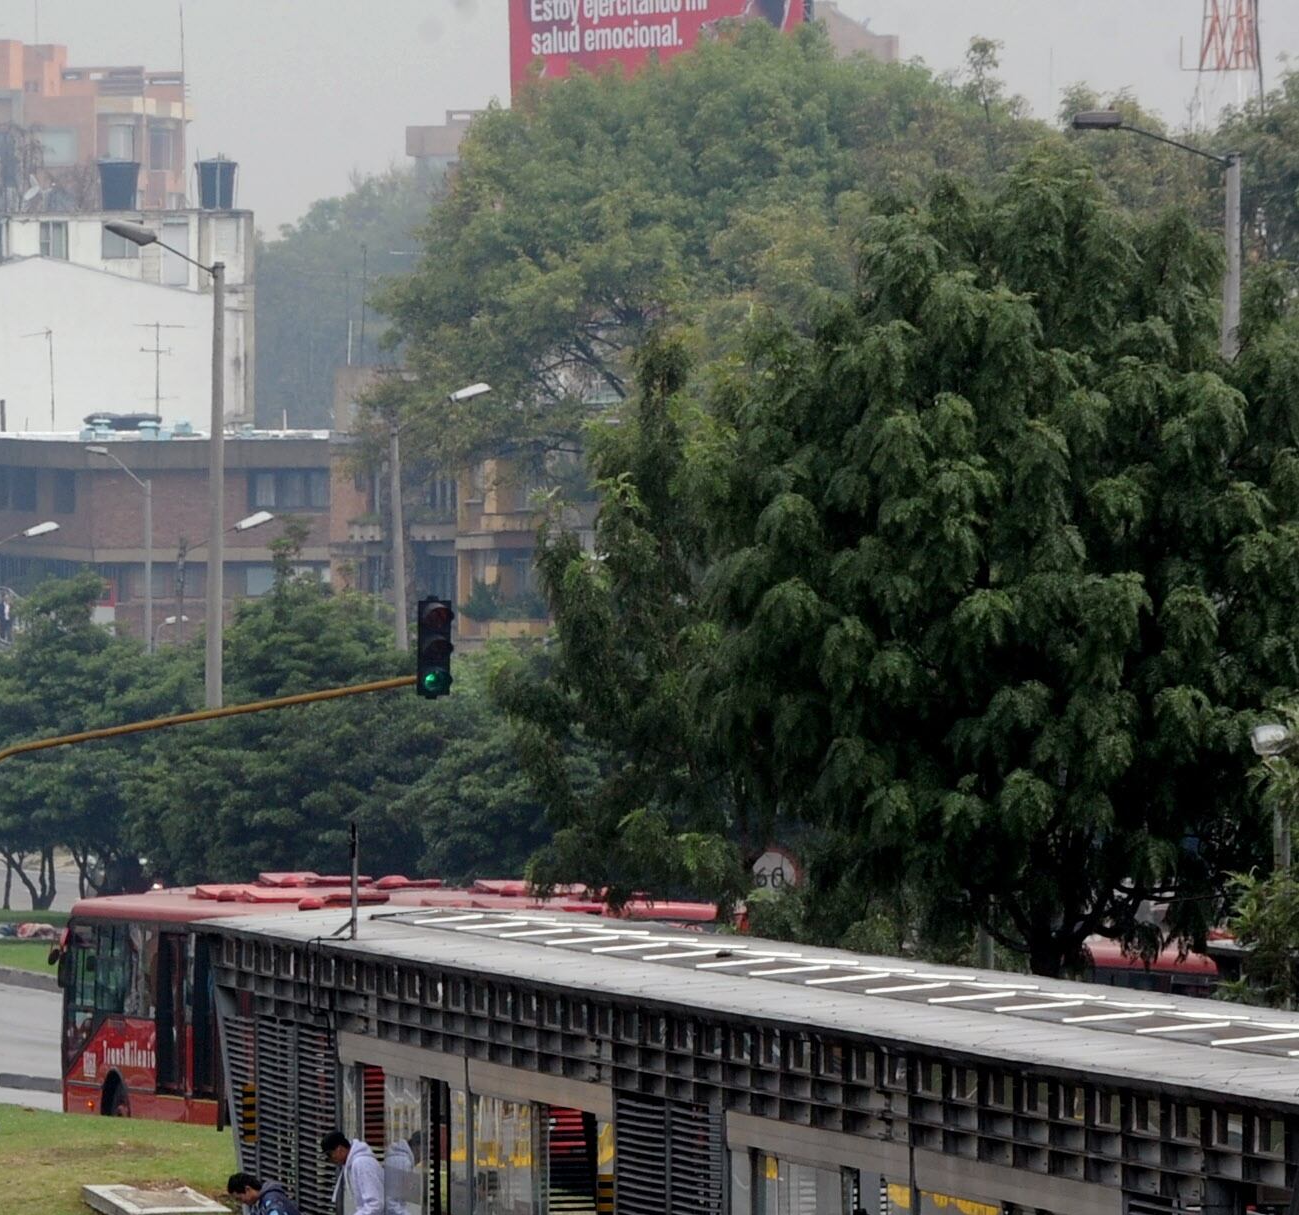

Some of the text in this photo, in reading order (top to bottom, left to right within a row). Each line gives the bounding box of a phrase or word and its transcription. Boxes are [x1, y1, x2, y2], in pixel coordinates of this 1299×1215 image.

[531, 0, 579, 26] Estoy
[531, 17, 683, 55] salud emocional.
[757, 867, 784, 888] 60
[103, 1040, 156, 1068] TransMilenio
